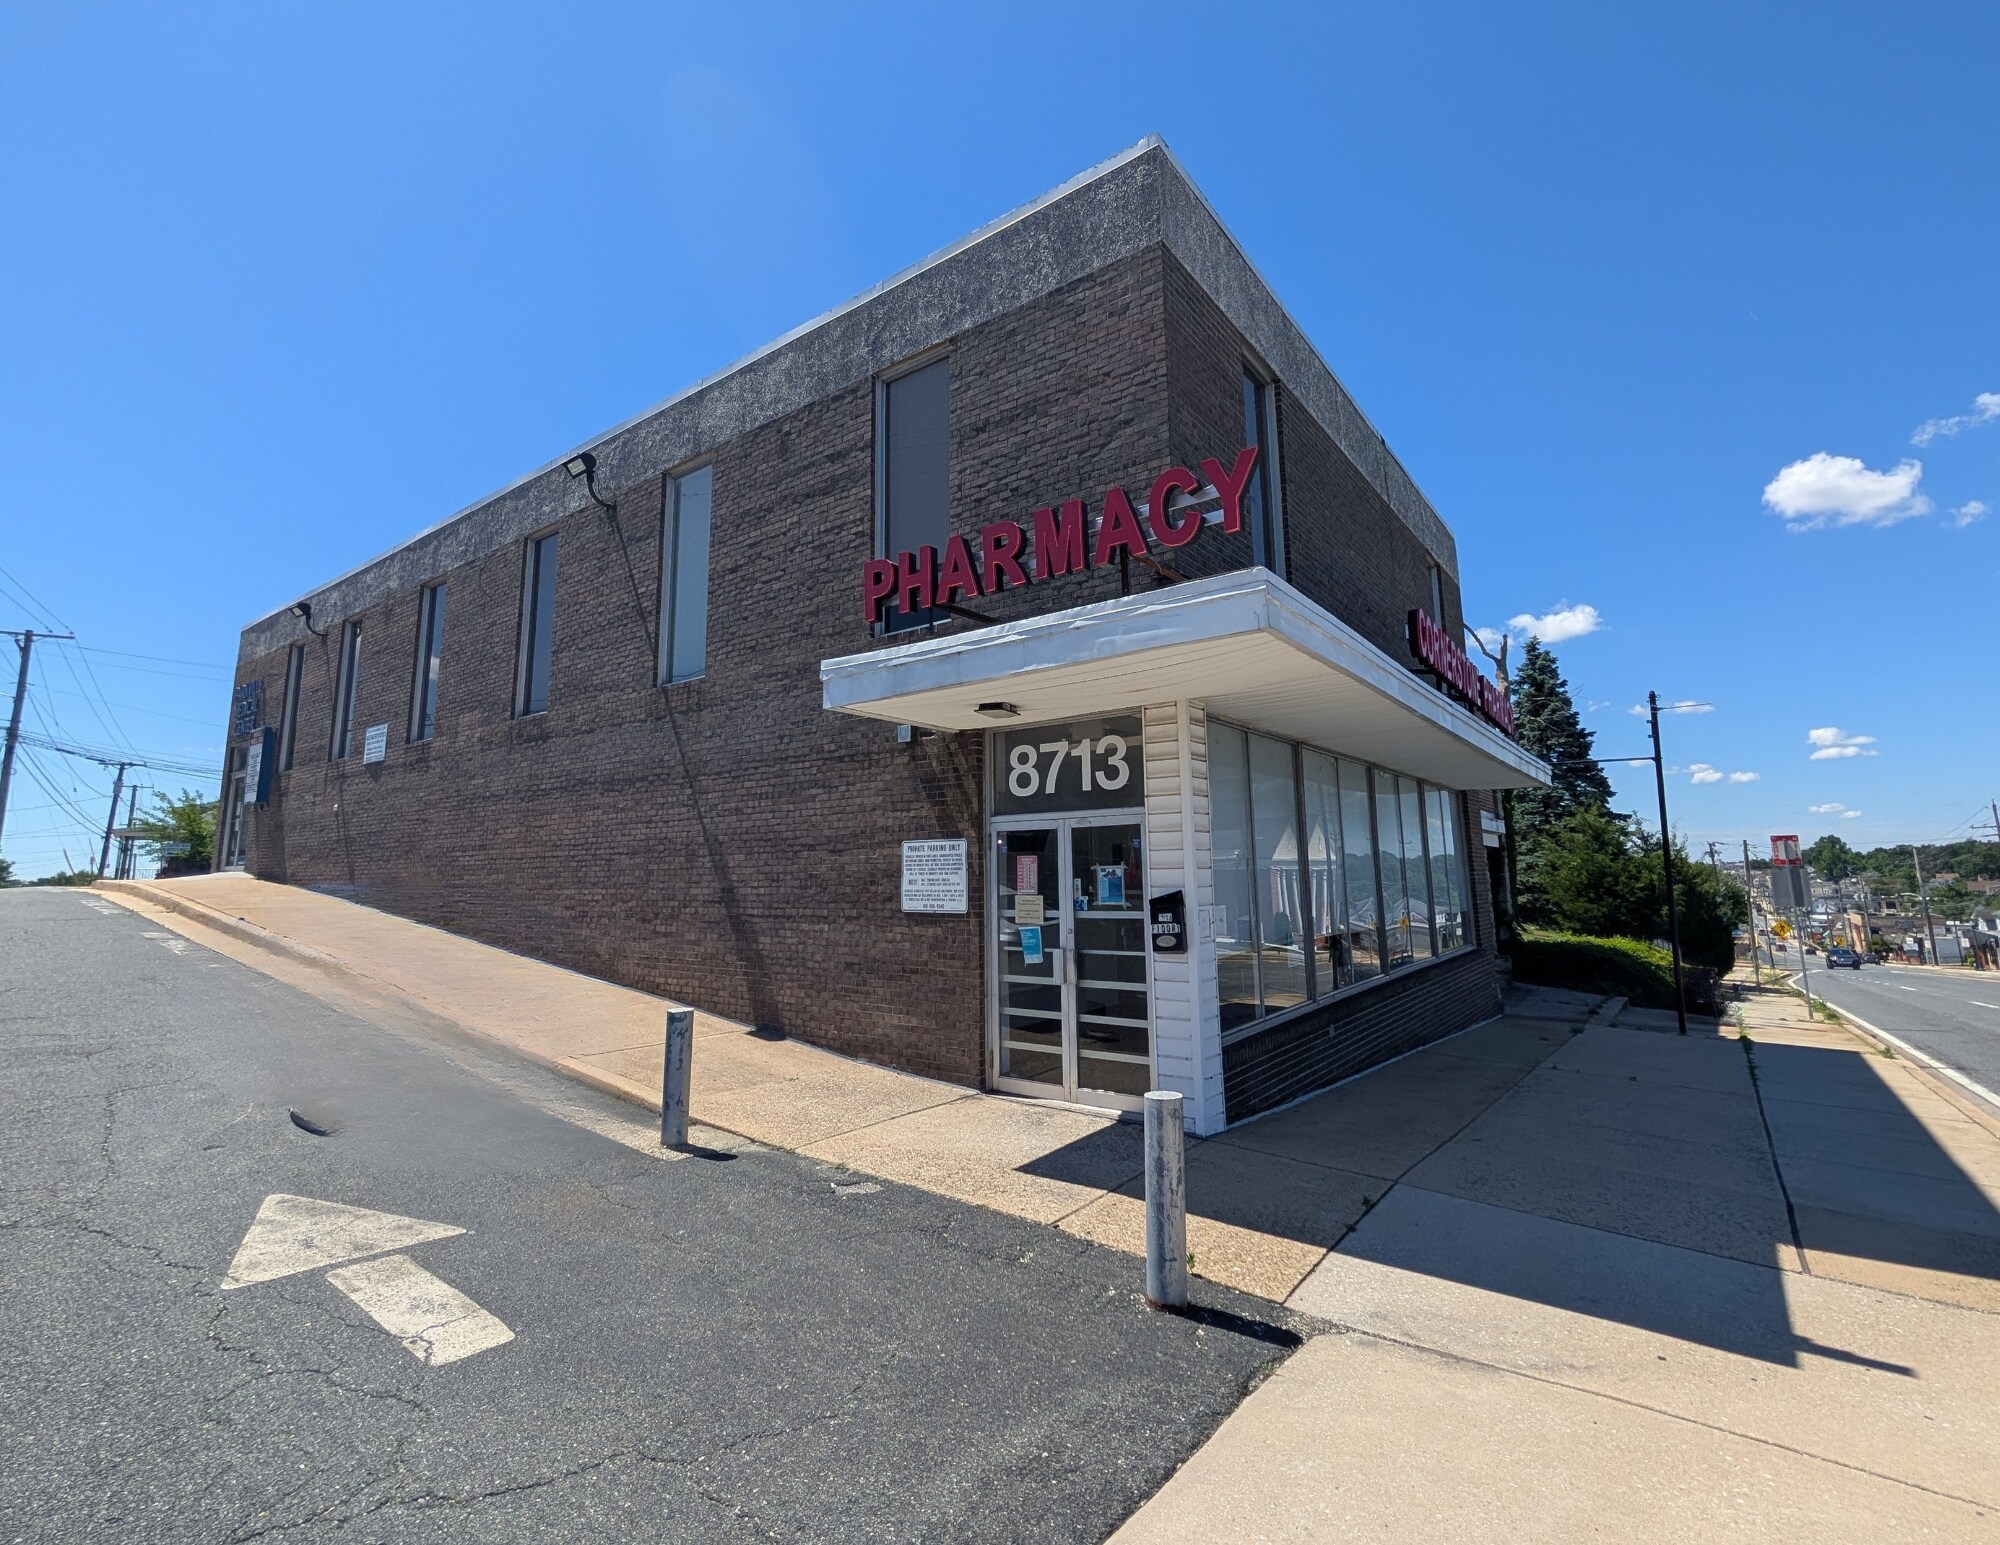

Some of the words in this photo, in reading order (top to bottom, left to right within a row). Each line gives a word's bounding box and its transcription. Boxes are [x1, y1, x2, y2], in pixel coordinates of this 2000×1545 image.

[863, 446, 1258, 622] PHARMACY
[1415, 608, 1481, 708] CORNERSTONE
[1009, 735, 1130, 796] 8713
[927, 844, 947, 852] PARKING
[948, 843, 961, 851] ONLY
